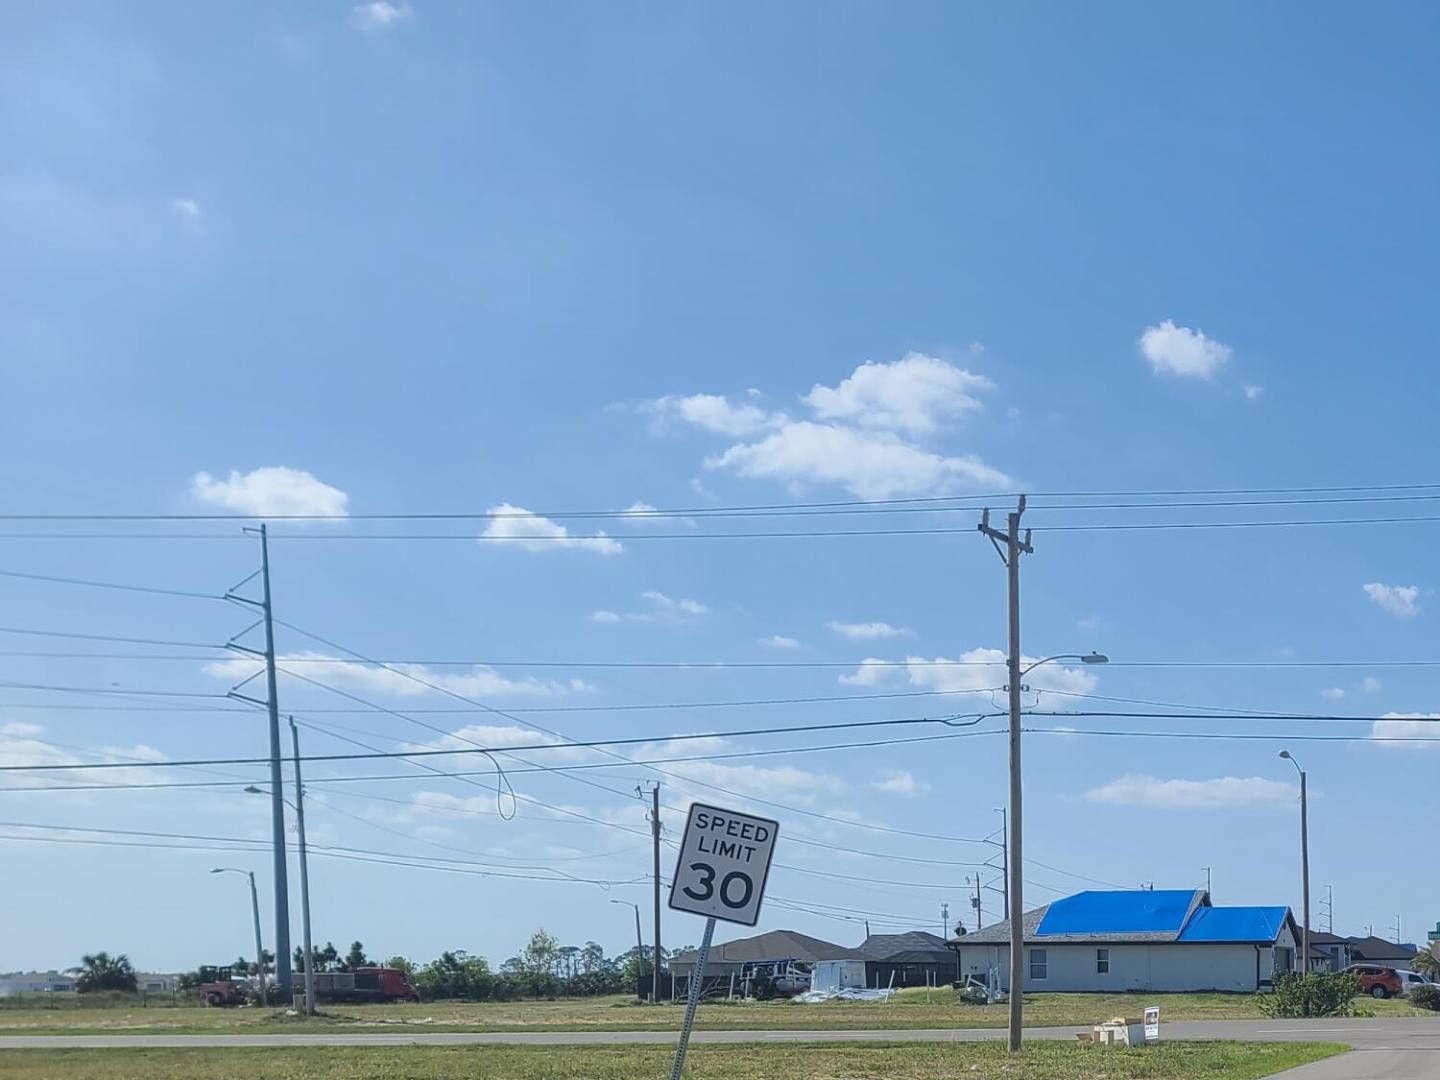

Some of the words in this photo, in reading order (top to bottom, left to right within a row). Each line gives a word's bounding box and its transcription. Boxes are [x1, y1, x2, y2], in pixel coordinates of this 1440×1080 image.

[695, 813, 769, 842] SPEED
[698, 836, 757, 862] LIMIT
[682, 862, 754, 909] 30
